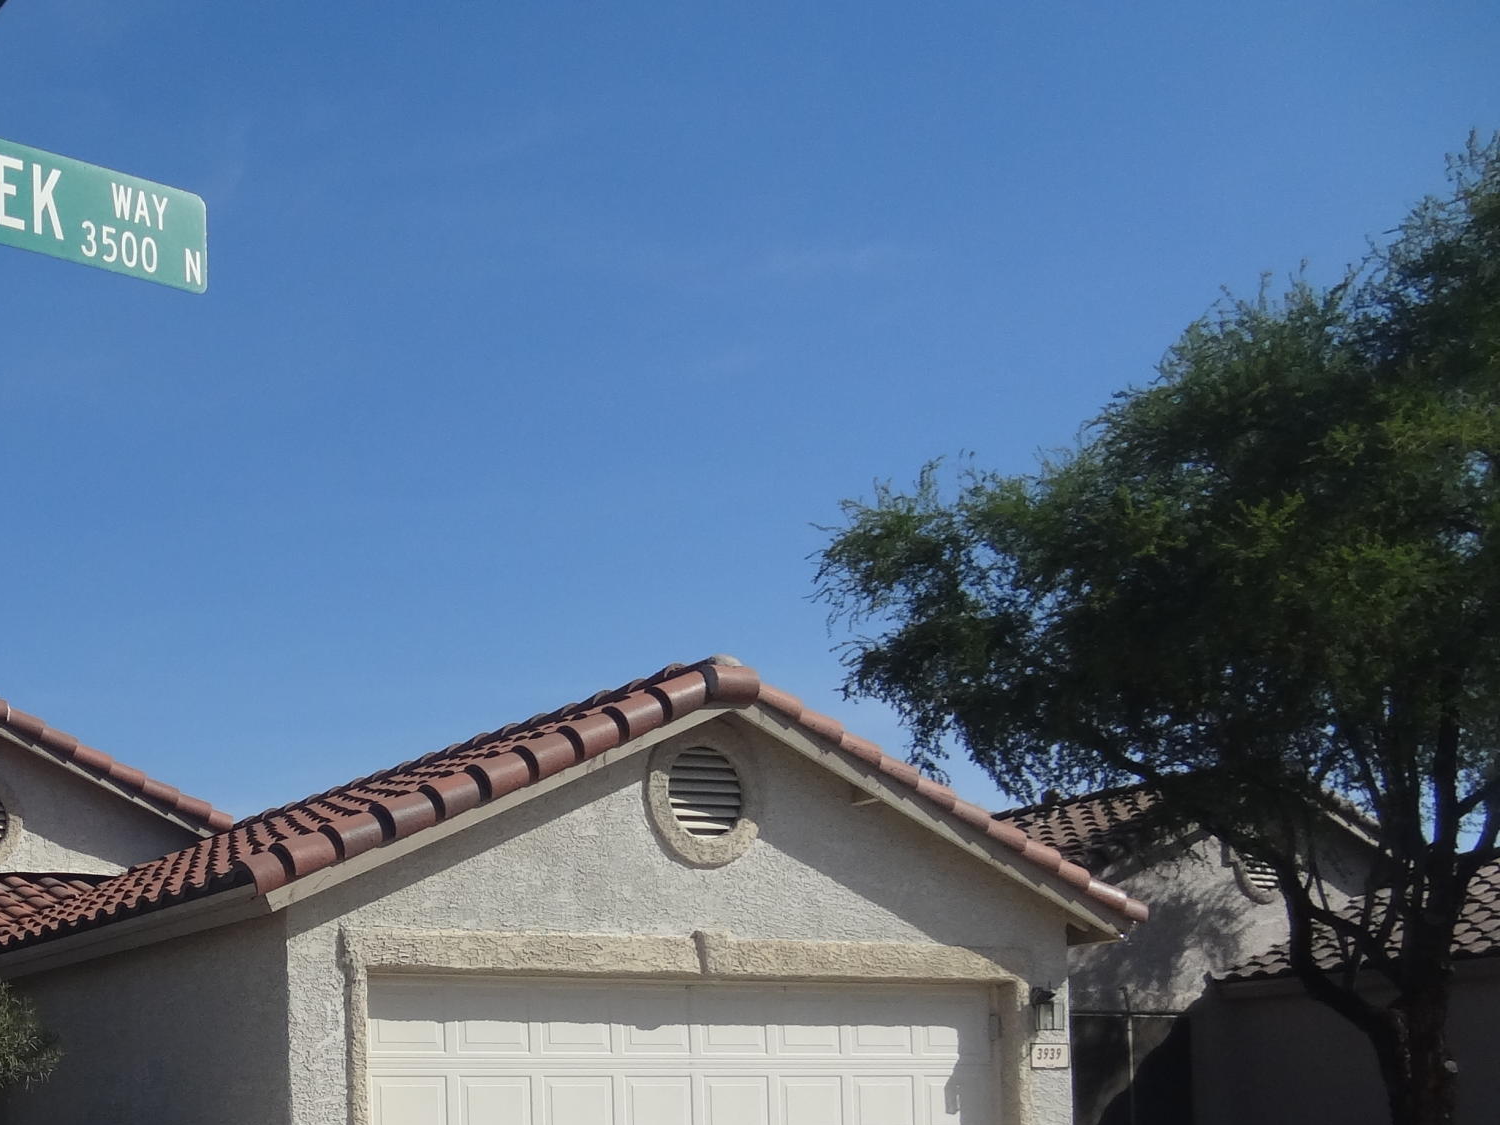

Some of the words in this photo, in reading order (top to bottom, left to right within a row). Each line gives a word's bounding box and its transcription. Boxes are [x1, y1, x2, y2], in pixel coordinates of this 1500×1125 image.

[111, 182, 168, 231] WAY
[81, 221, 158, 274] 3500
[185, 248, 202, 286] N
